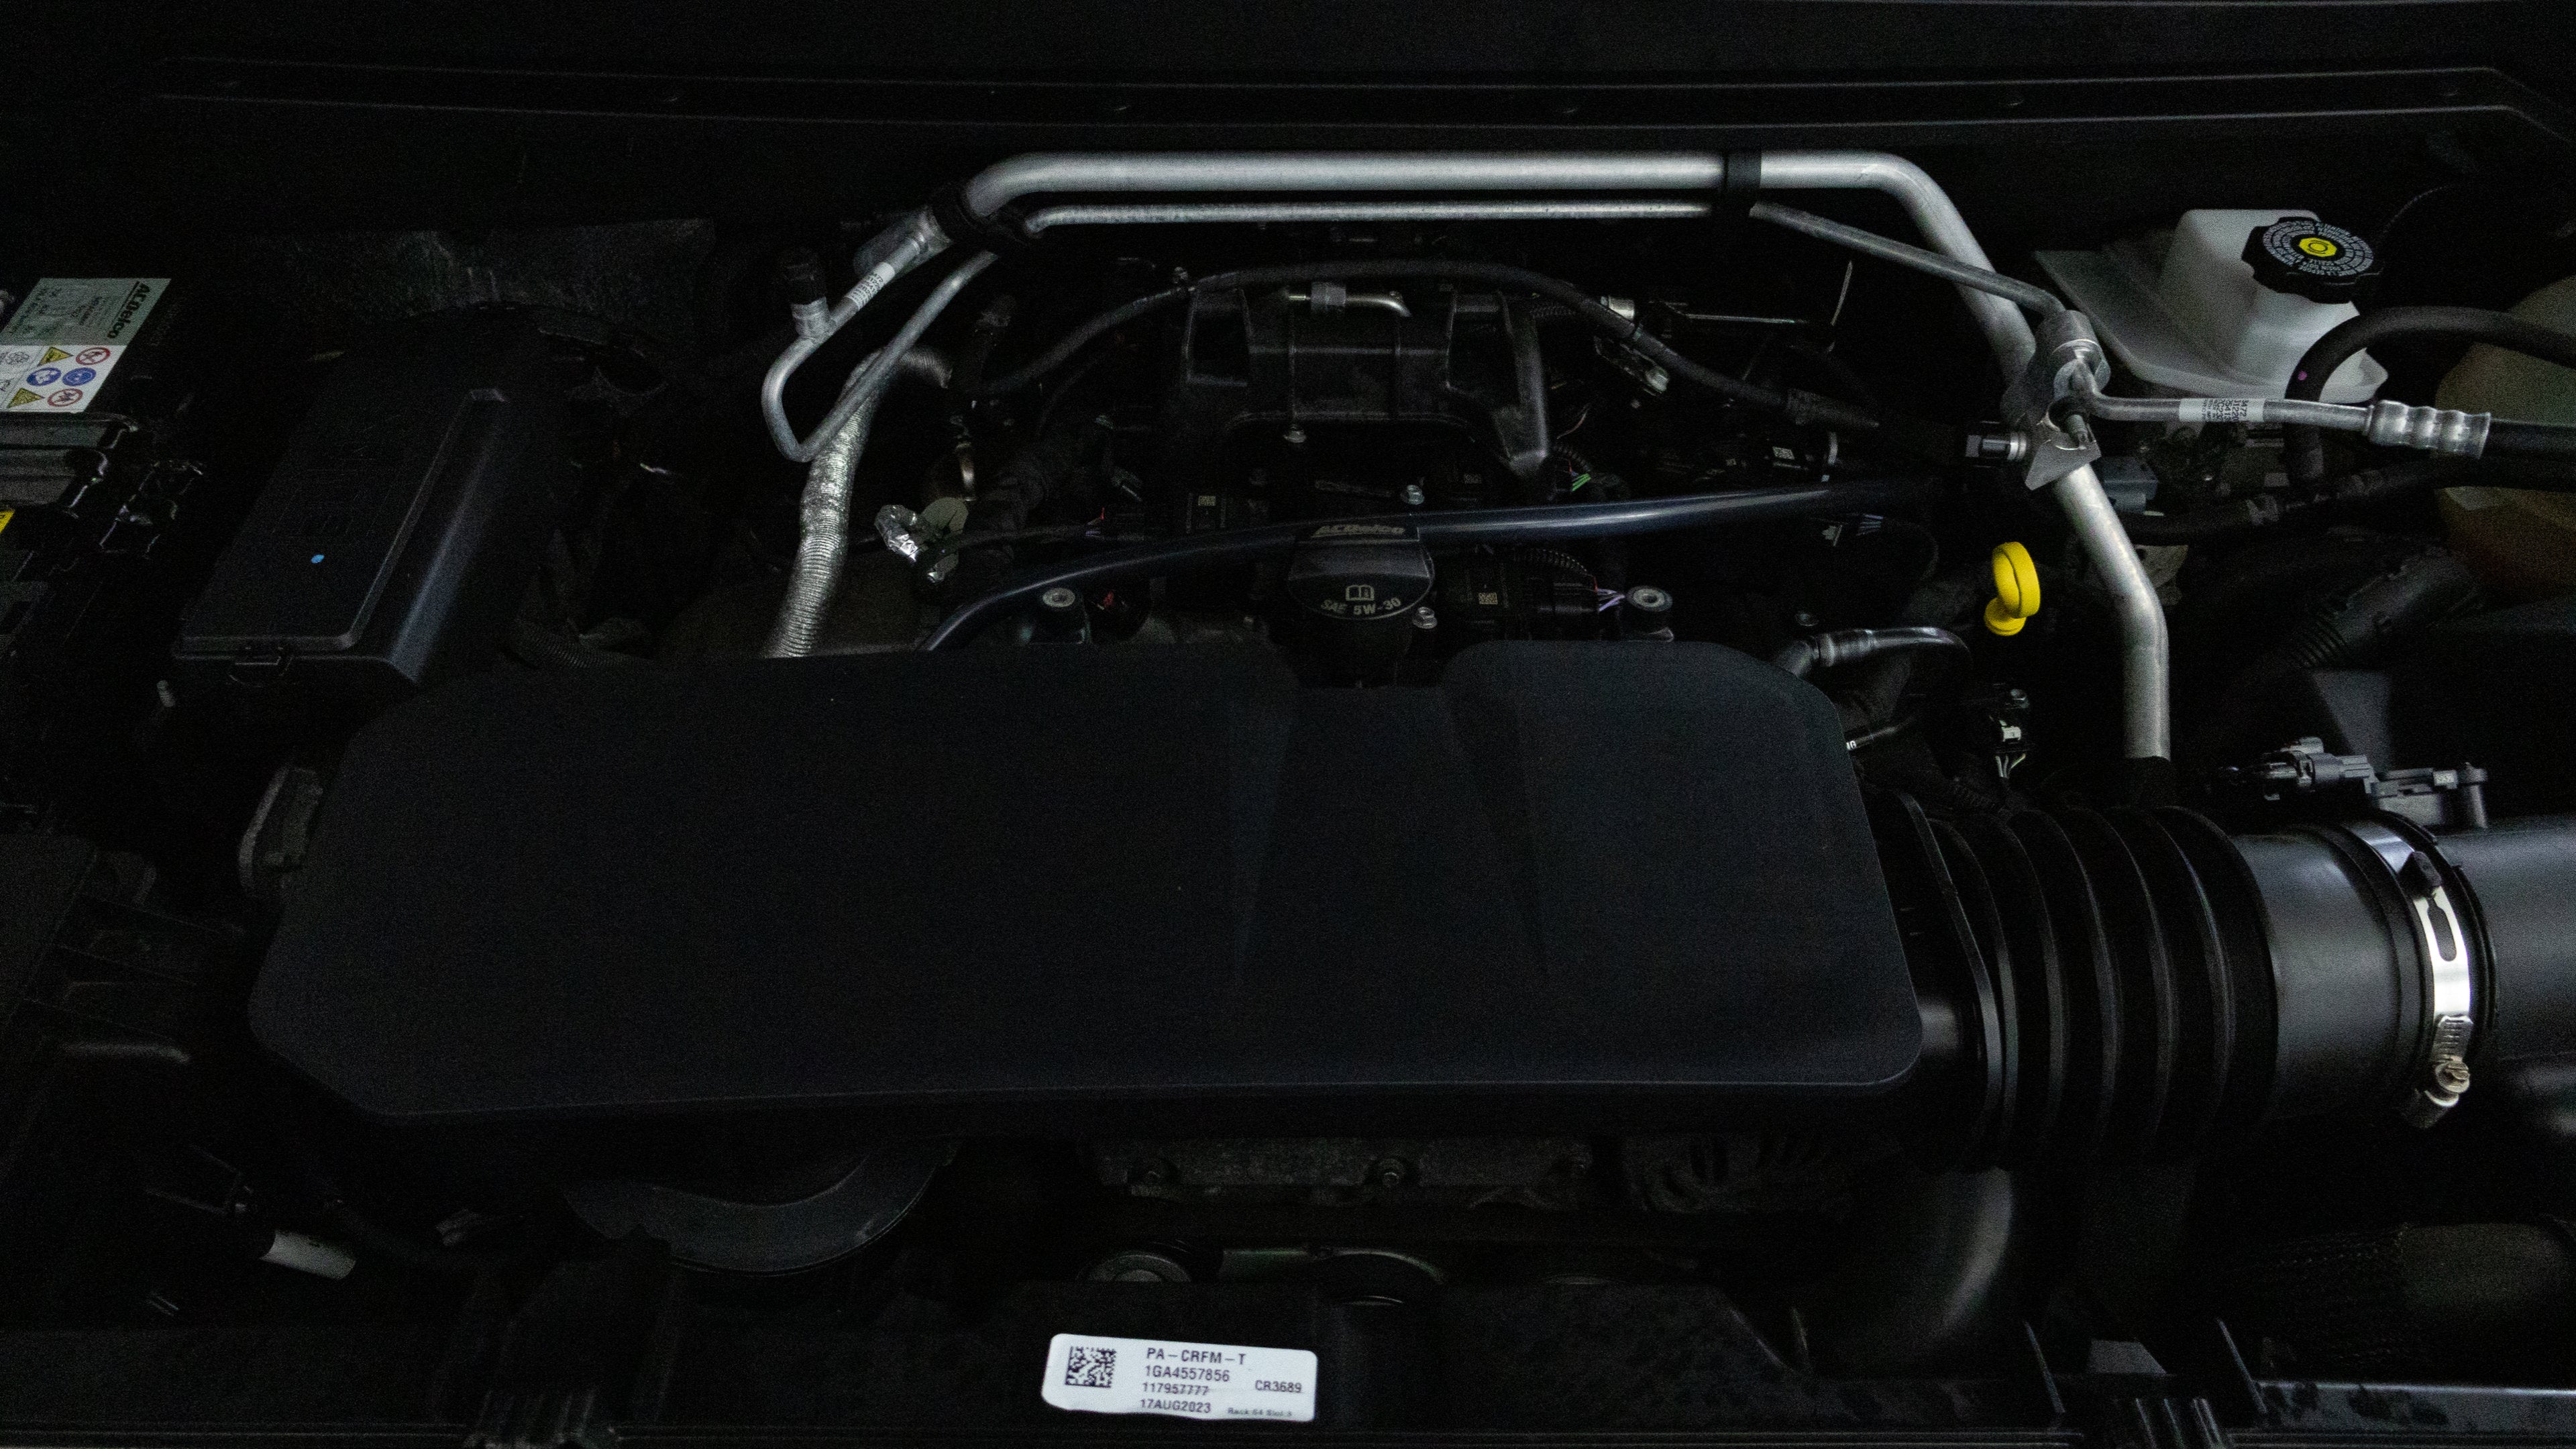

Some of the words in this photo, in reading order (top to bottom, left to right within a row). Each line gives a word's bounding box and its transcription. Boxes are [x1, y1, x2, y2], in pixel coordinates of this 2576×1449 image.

[107, 282, 150, 339] ACDelco
[1320, 598, 1347, 614] SAE
[1352, 597, 1402, 615] 5W-30
[1144, 1365, 1230, 1382] 1GA4557856
[1142, 1382, 1210, 1395] 117957777
[1255, 1379, 1303, 1393] CR3689
[1140, 1399, 1212, 1413] 17AUG2023
